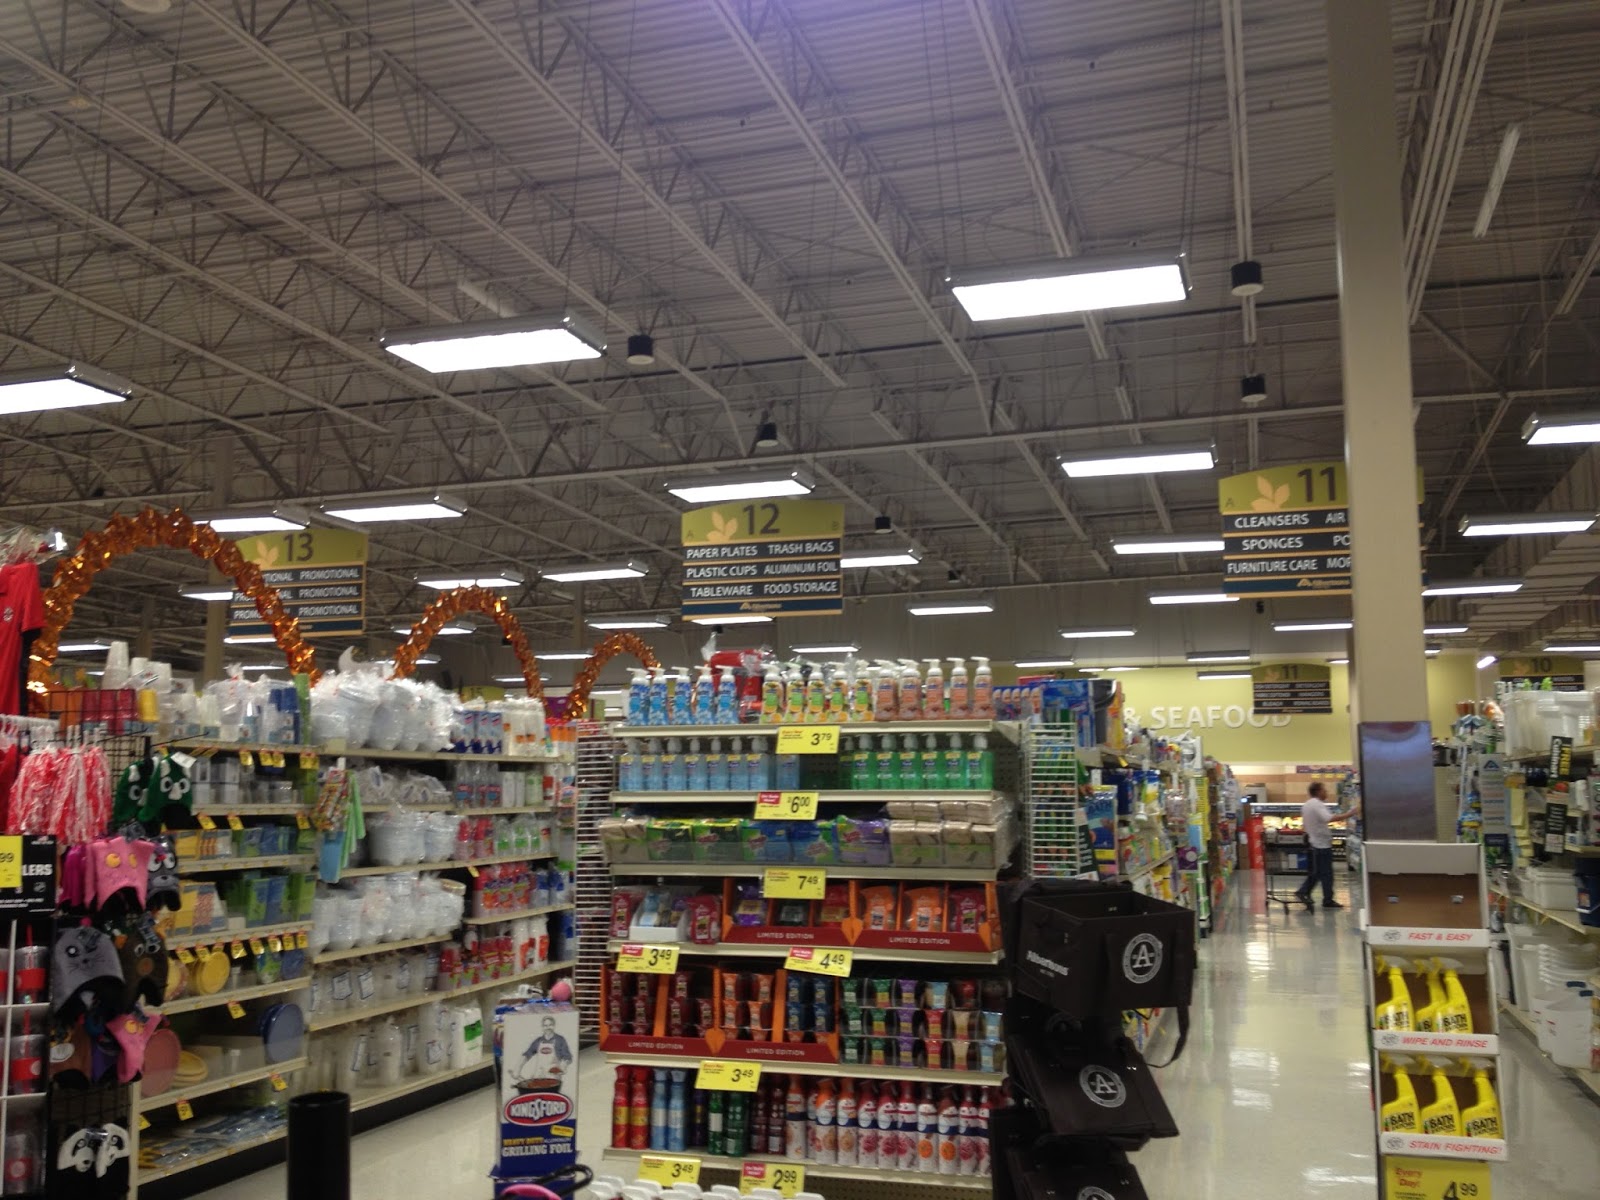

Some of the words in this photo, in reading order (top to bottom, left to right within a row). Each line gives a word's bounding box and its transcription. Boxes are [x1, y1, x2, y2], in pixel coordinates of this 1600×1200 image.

[1297, 467, 1336, 503] 11
[743, 503, 781, 535] 12
[1234, 513, 1310, 529] CLEANSERS
[1325, 512, 1346, 525] AIR
[283, 533, 314, 562] 13
[686, 548, 719, 560] PAPER
[720, 545, 758, 558] PLATES
[768, 543, 803, 555] TRASH
[805, 541, 835, 553] BAGS
[1241, 536, 1304, 551] SPONGES
[686, 567, 727, 579] PLASTIC
[729, 565, 758, 577] CUPS
[763, 562, 816, 575] ALUMINUM
[816, 560, 838, 572] FOIL
[1227, 560, 1289, 574] FURNITURE
[1289, 558, 1319, 572] CARE
[300, 568, 360, 580] PROMOTIONAL
[299, 586, 359, 598] PROMOTIONAL
[690, 585, 754, 598] TABLEWARE
[763, 583, 792, 594] FOOD
[793, 581, 838, 593] STORAGE
[298, 604, 359, 617] PROMOTIONAL
[1281, 665, 1299, 680] 11
[1151, 705, 1293, 730] SEAFOOD
[22, 863, 54, 876] LERS
[756, 931, 784, 939] LIMITED
[785, 932, 815, 940] EDITION
[889, 936, 918, 944] LIMITED
[919, 937, 951, 945] EDITION
[1408, 932, 1433, 941] FAST
[1445, 933, 1473, 941] EASY
[628, 1040, 655, 1048] LIMITED
[655, 1042, 684, 1050] EDITION
[1401, 1036, 1429, 1046] WIPE
[1431, 1037, 1454, 1047] AND
[1455, 1038, 1489, 1049] RINSE
[746, 1047, 774, 1055] LIMITED
[775, 1048, 805, 1056] EDITION
[510, 1099, 566, 1120] KINGSFORD
[503, 1145, 547, 1156] GRILLING
[550, 1143, 572, 1153] FOIL
[1409, 1140, 1442, 1150] STAIN
